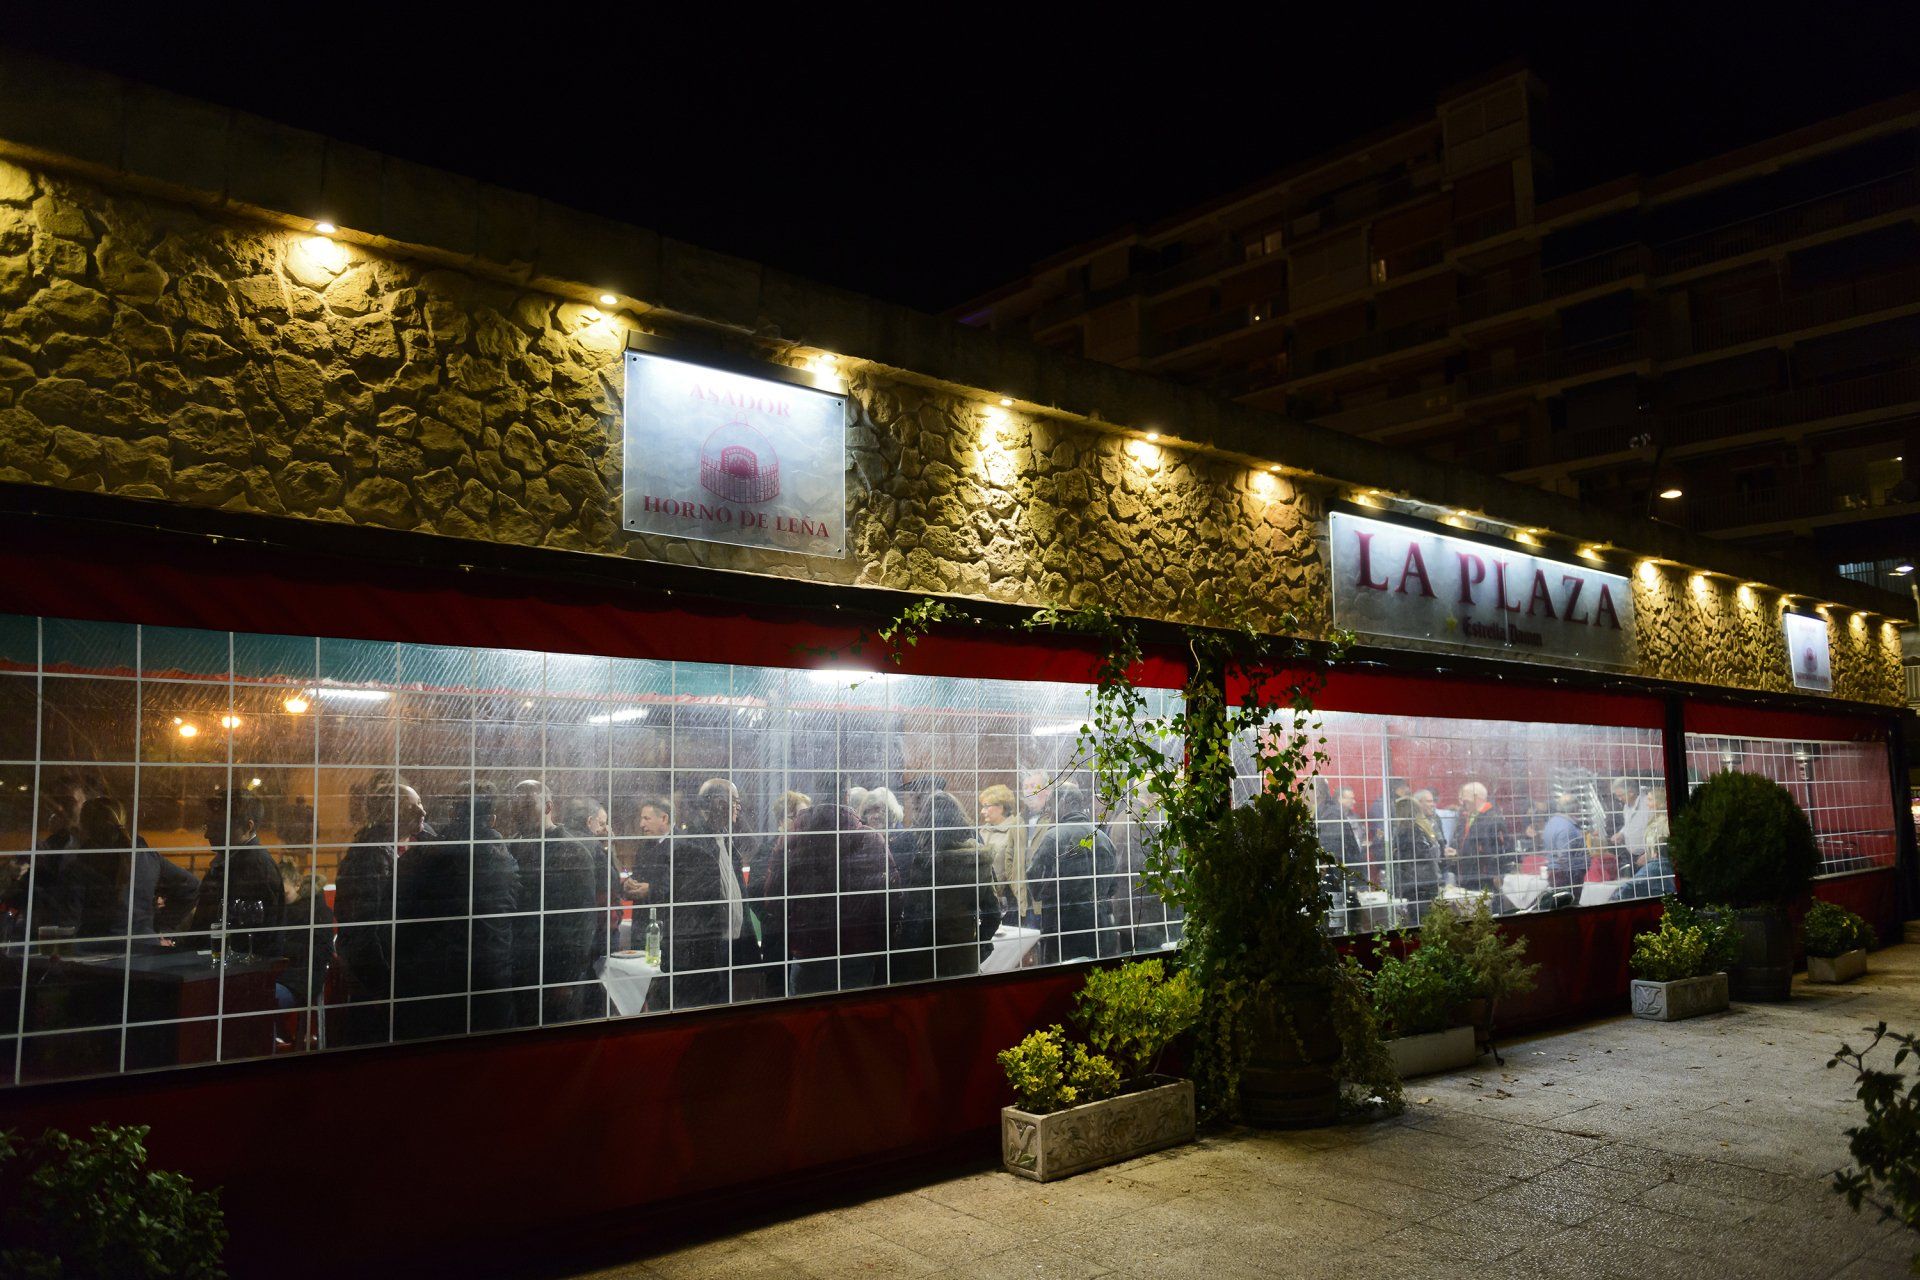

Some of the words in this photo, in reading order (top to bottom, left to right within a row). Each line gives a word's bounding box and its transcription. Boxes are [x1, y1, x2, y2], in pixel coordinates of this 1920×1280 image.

[690, 383, 791, 417] ASADOR
[644, 495, 732, 524] HORNO
[739, 510, 768, 529] DE
[776, 516, 829, 538] LEÑA
[1354, 530, 1437, 599] LA
[1456, 551, 1622, 630] PLAZA
